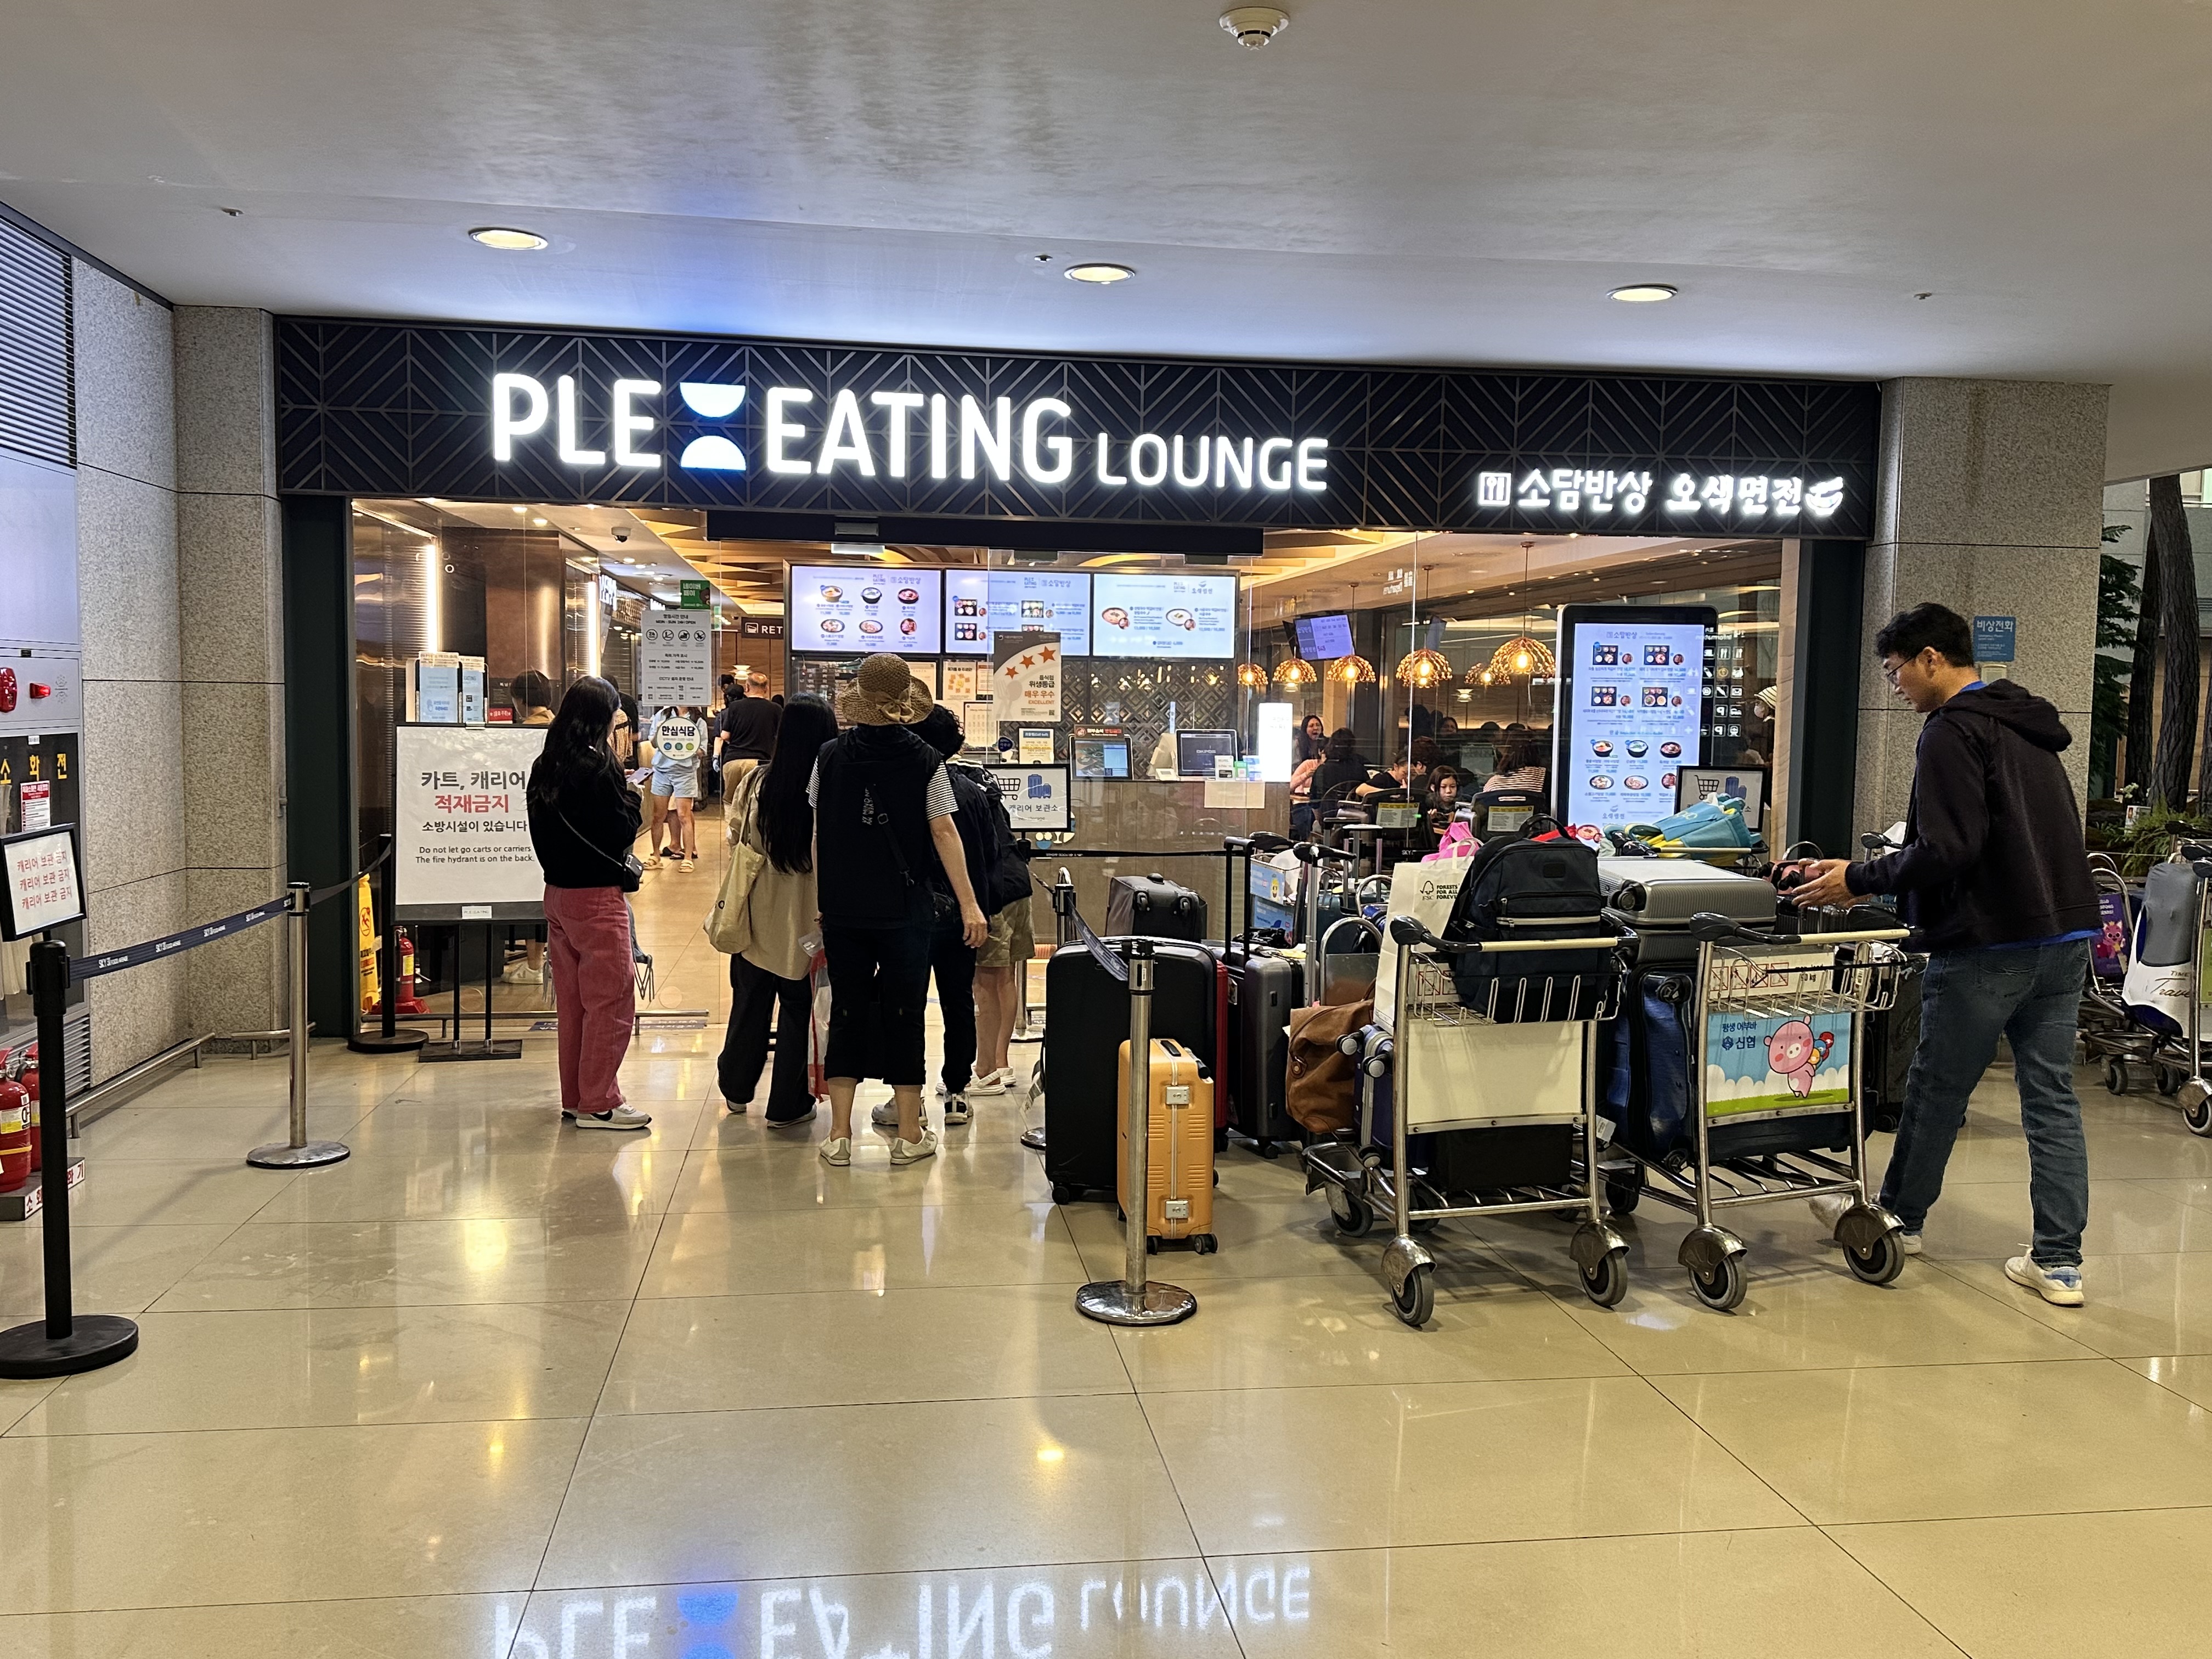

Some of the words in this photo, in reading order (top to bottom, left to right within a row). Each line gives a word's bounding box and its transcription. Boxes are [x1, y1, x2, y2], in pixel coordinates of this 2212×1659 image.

[493, 373, 661, 468] PLE
[768, 386, 1073, 485] EATING
[1097, 432, 1328, 491] LOUNGE
[1518, 469, 1652, 514] 소담반상
[1977, 620, 2014, 633] 비상전화
[1024, 690, 1039, 698] 매우
[1040, 690, 1055, 698] 우수
[662, 726, 696, 736] 안심식당
[421, 771, 465, 791] 카트,
[471, 771, 526, 790] 캐리어
[434, 794, 509, 814] 적재금지
[422, 821, 479, 832] 소방시설이
[483, 820, 527, 832] 있습니다
[17, 856, 39, 873] 캐리어
[41, 854, 54, 867] 보관
[448, 855, 478, 864] hydrant
[20, 876, 41, 891] 캐리어
[43, 871, 56, 885] 보관
[58, 868, 71, 882] 금지
[22, 894, 42, 910] 캐리어
[44, 889, 58, 904] 보관
[60, 887, 72, 900] 금지
[2150, 978, 2191, 998] Trave
[1722, 1023, 1735, 1032] 평생
[1736, 1021, 1757, 1031] 어부바
[1735, 1035, 1756, 1050] 신협
